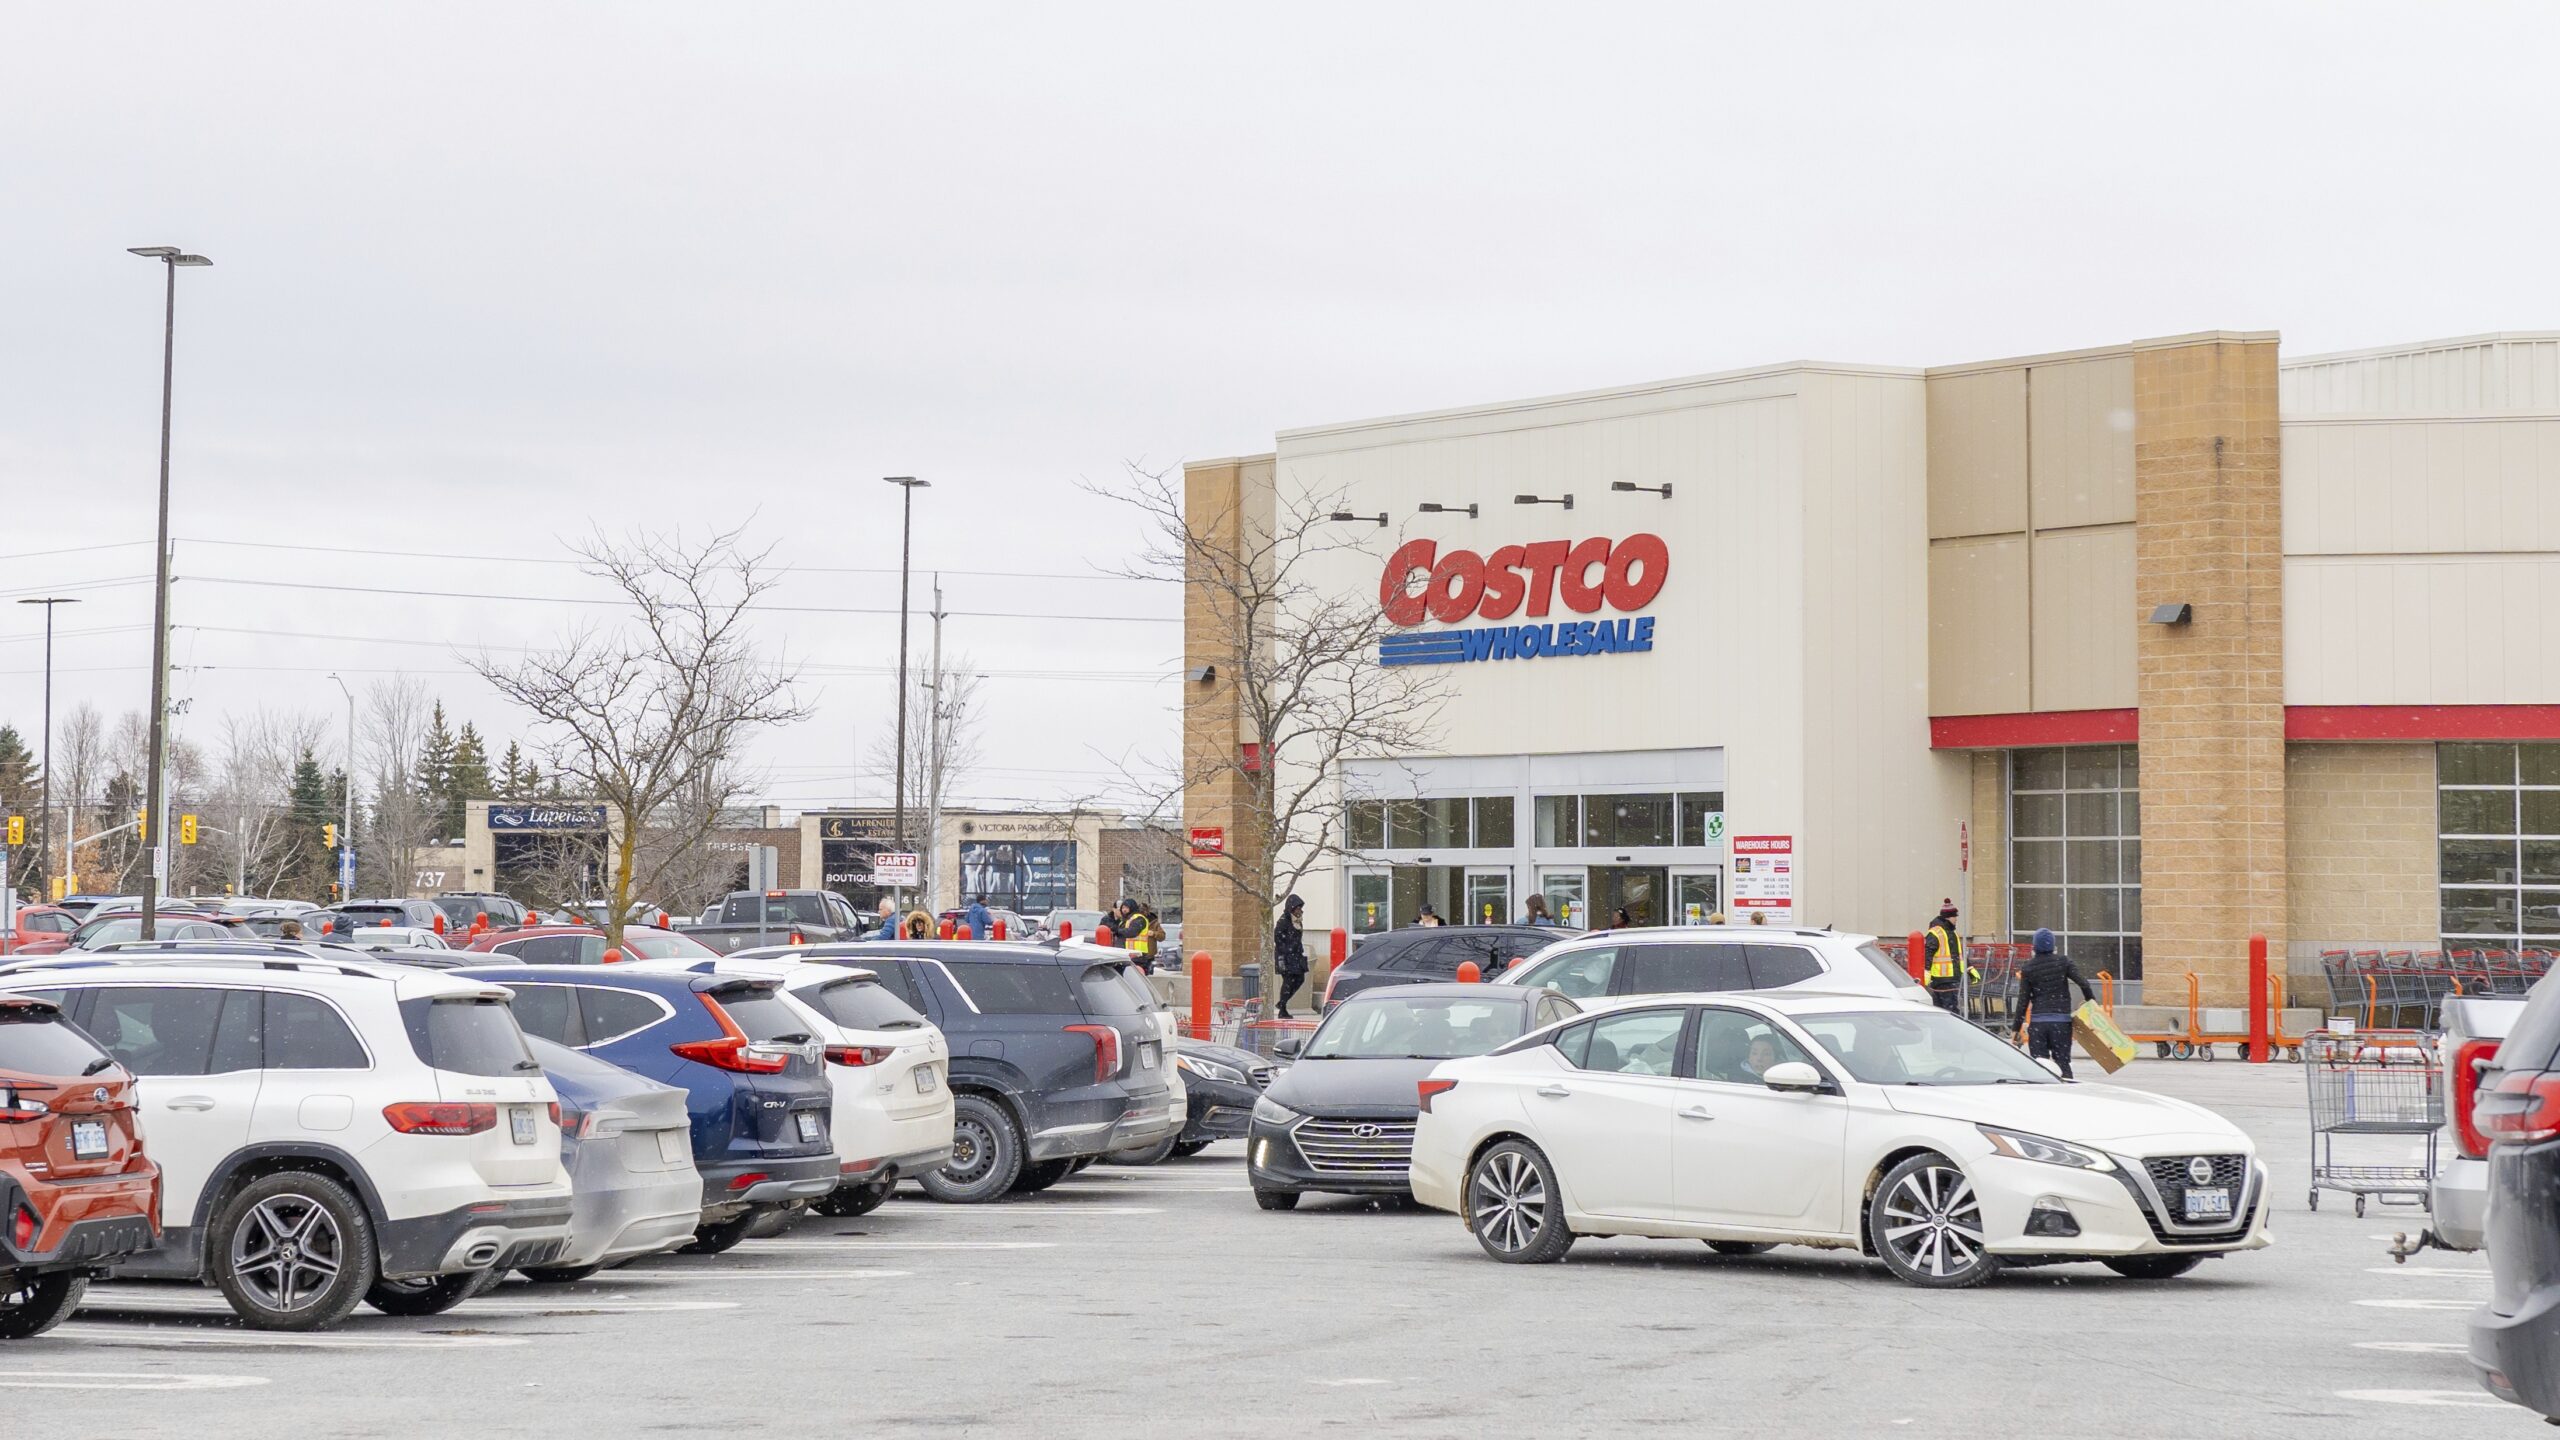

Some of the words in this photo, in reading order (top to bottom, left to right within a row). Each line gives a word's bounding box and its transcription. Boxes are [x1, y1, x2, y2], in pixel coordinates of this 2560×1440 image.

[1379, 533, 1669, 626] COSTCO
[1461, 616, 1655, 662] WHOLESALE
[851, 819, 896, 827] LAFRENIER
[979, 824, 1015, 832] VICTORIA
[1017, 824, 1038, 832] PARK
[1039, 823, 1076, 832] MEDIS
[1735, 840, 1770, 850] WAREHOUSE
[1770, 840, 1790, 849] HOURS
[877, 856, 915, 866] CARTS
[414, 870, 446, 888] 737
[826, 874, 875, 882] BOUTIQUE
